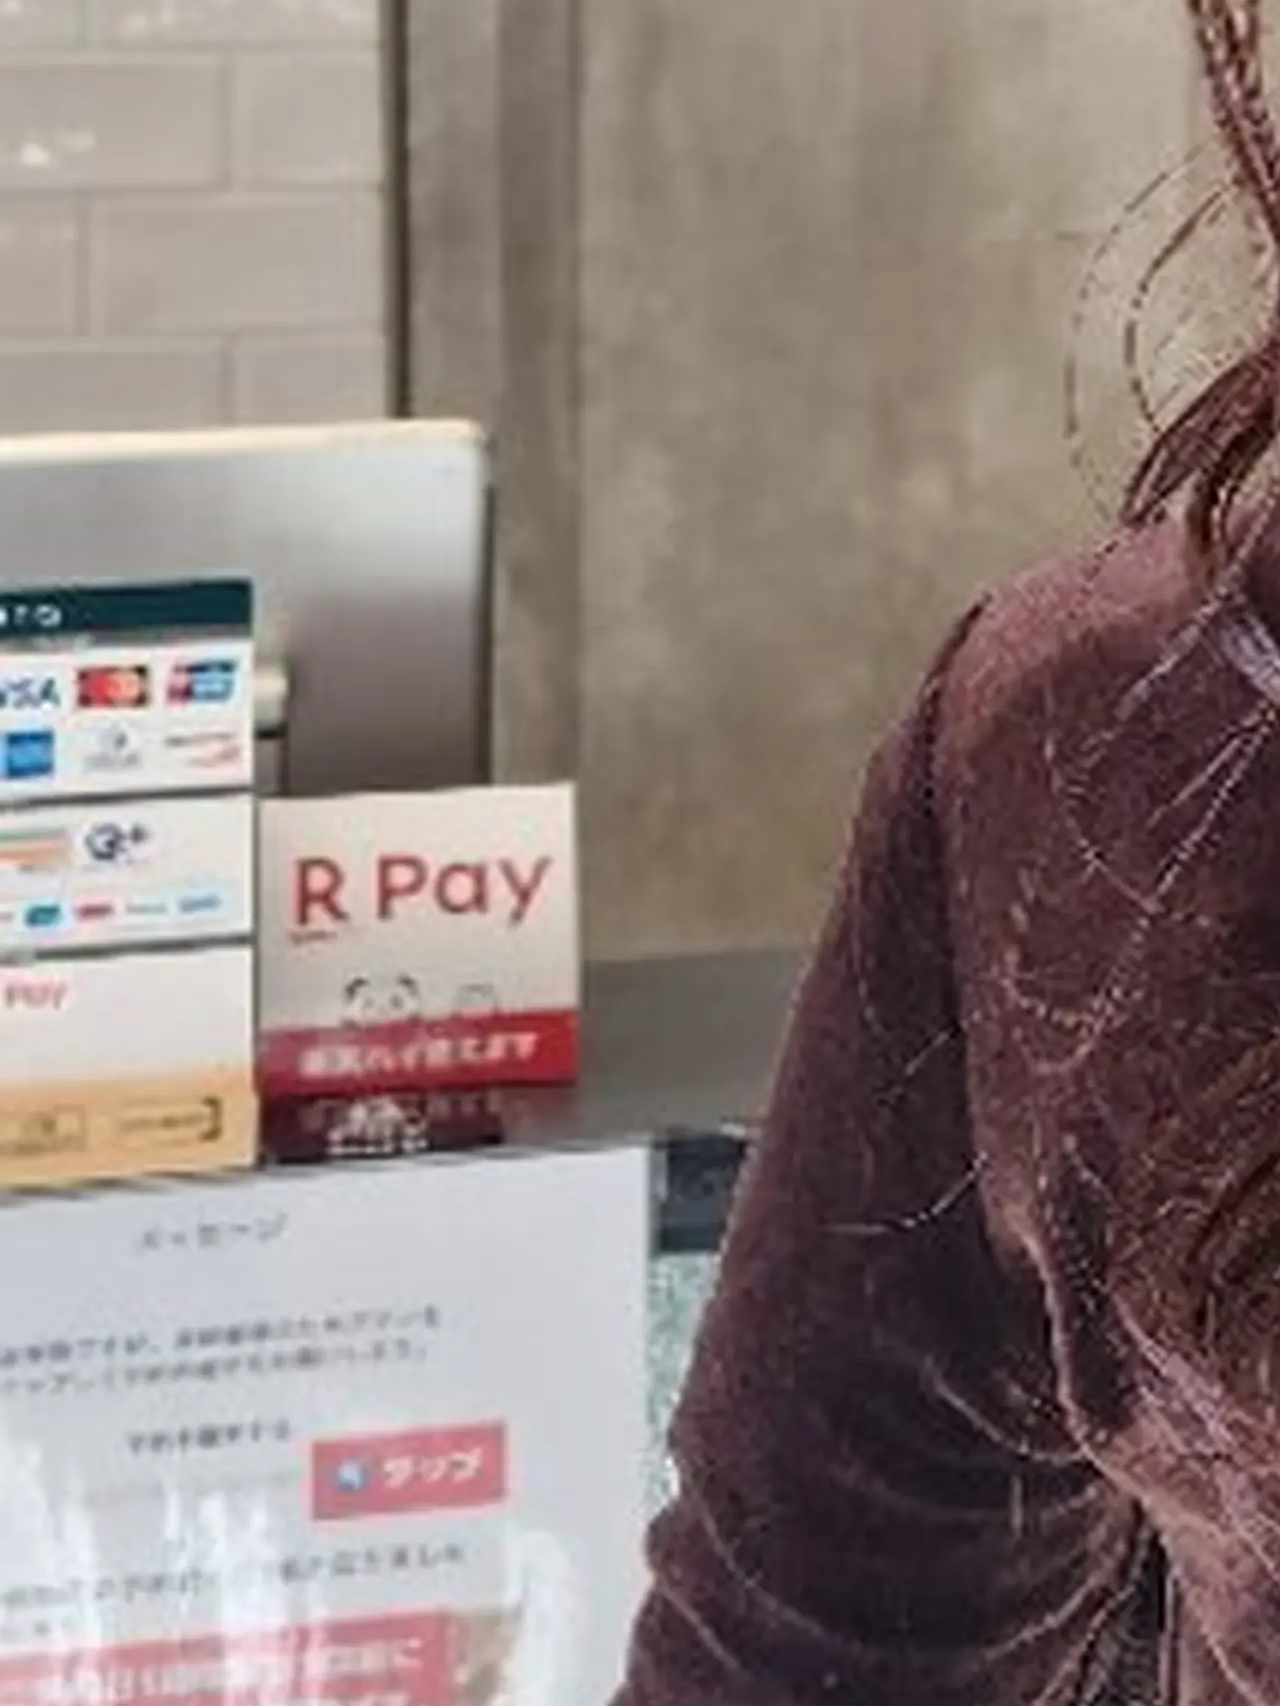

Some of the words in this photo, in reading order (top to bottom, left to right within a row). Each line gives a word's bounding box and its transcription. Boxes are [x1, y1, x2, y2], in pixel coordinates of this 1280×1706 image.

[292, 856, 348, 930] R
[374, 853, 555, 926] Pay
[380, 1445, 484, 1490] タップ
